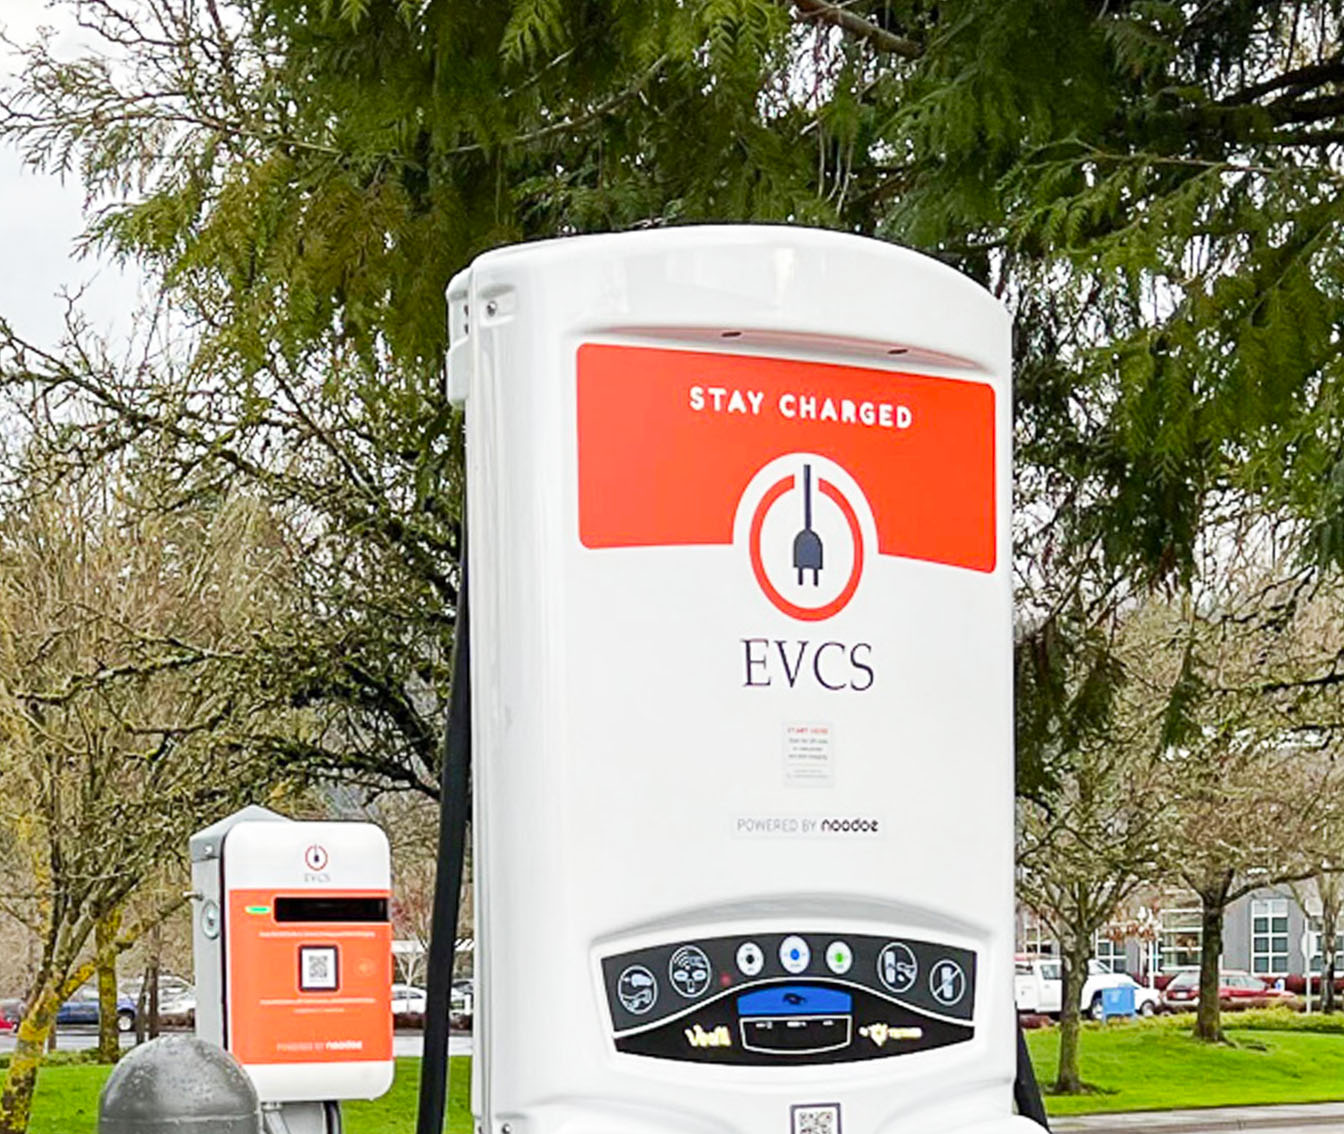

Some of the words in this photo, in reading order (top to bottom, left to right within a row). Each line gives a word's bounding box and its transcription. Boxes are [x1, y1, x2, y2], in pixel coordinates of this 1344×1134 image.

[689, 385, 765, 415] STAY
[778, 393, 913, 429] CHARGED
[740, 637, 875, 692] EVCS
[736, 818, 799, 833] POWERED
[801, 818, 818, 833] BY
